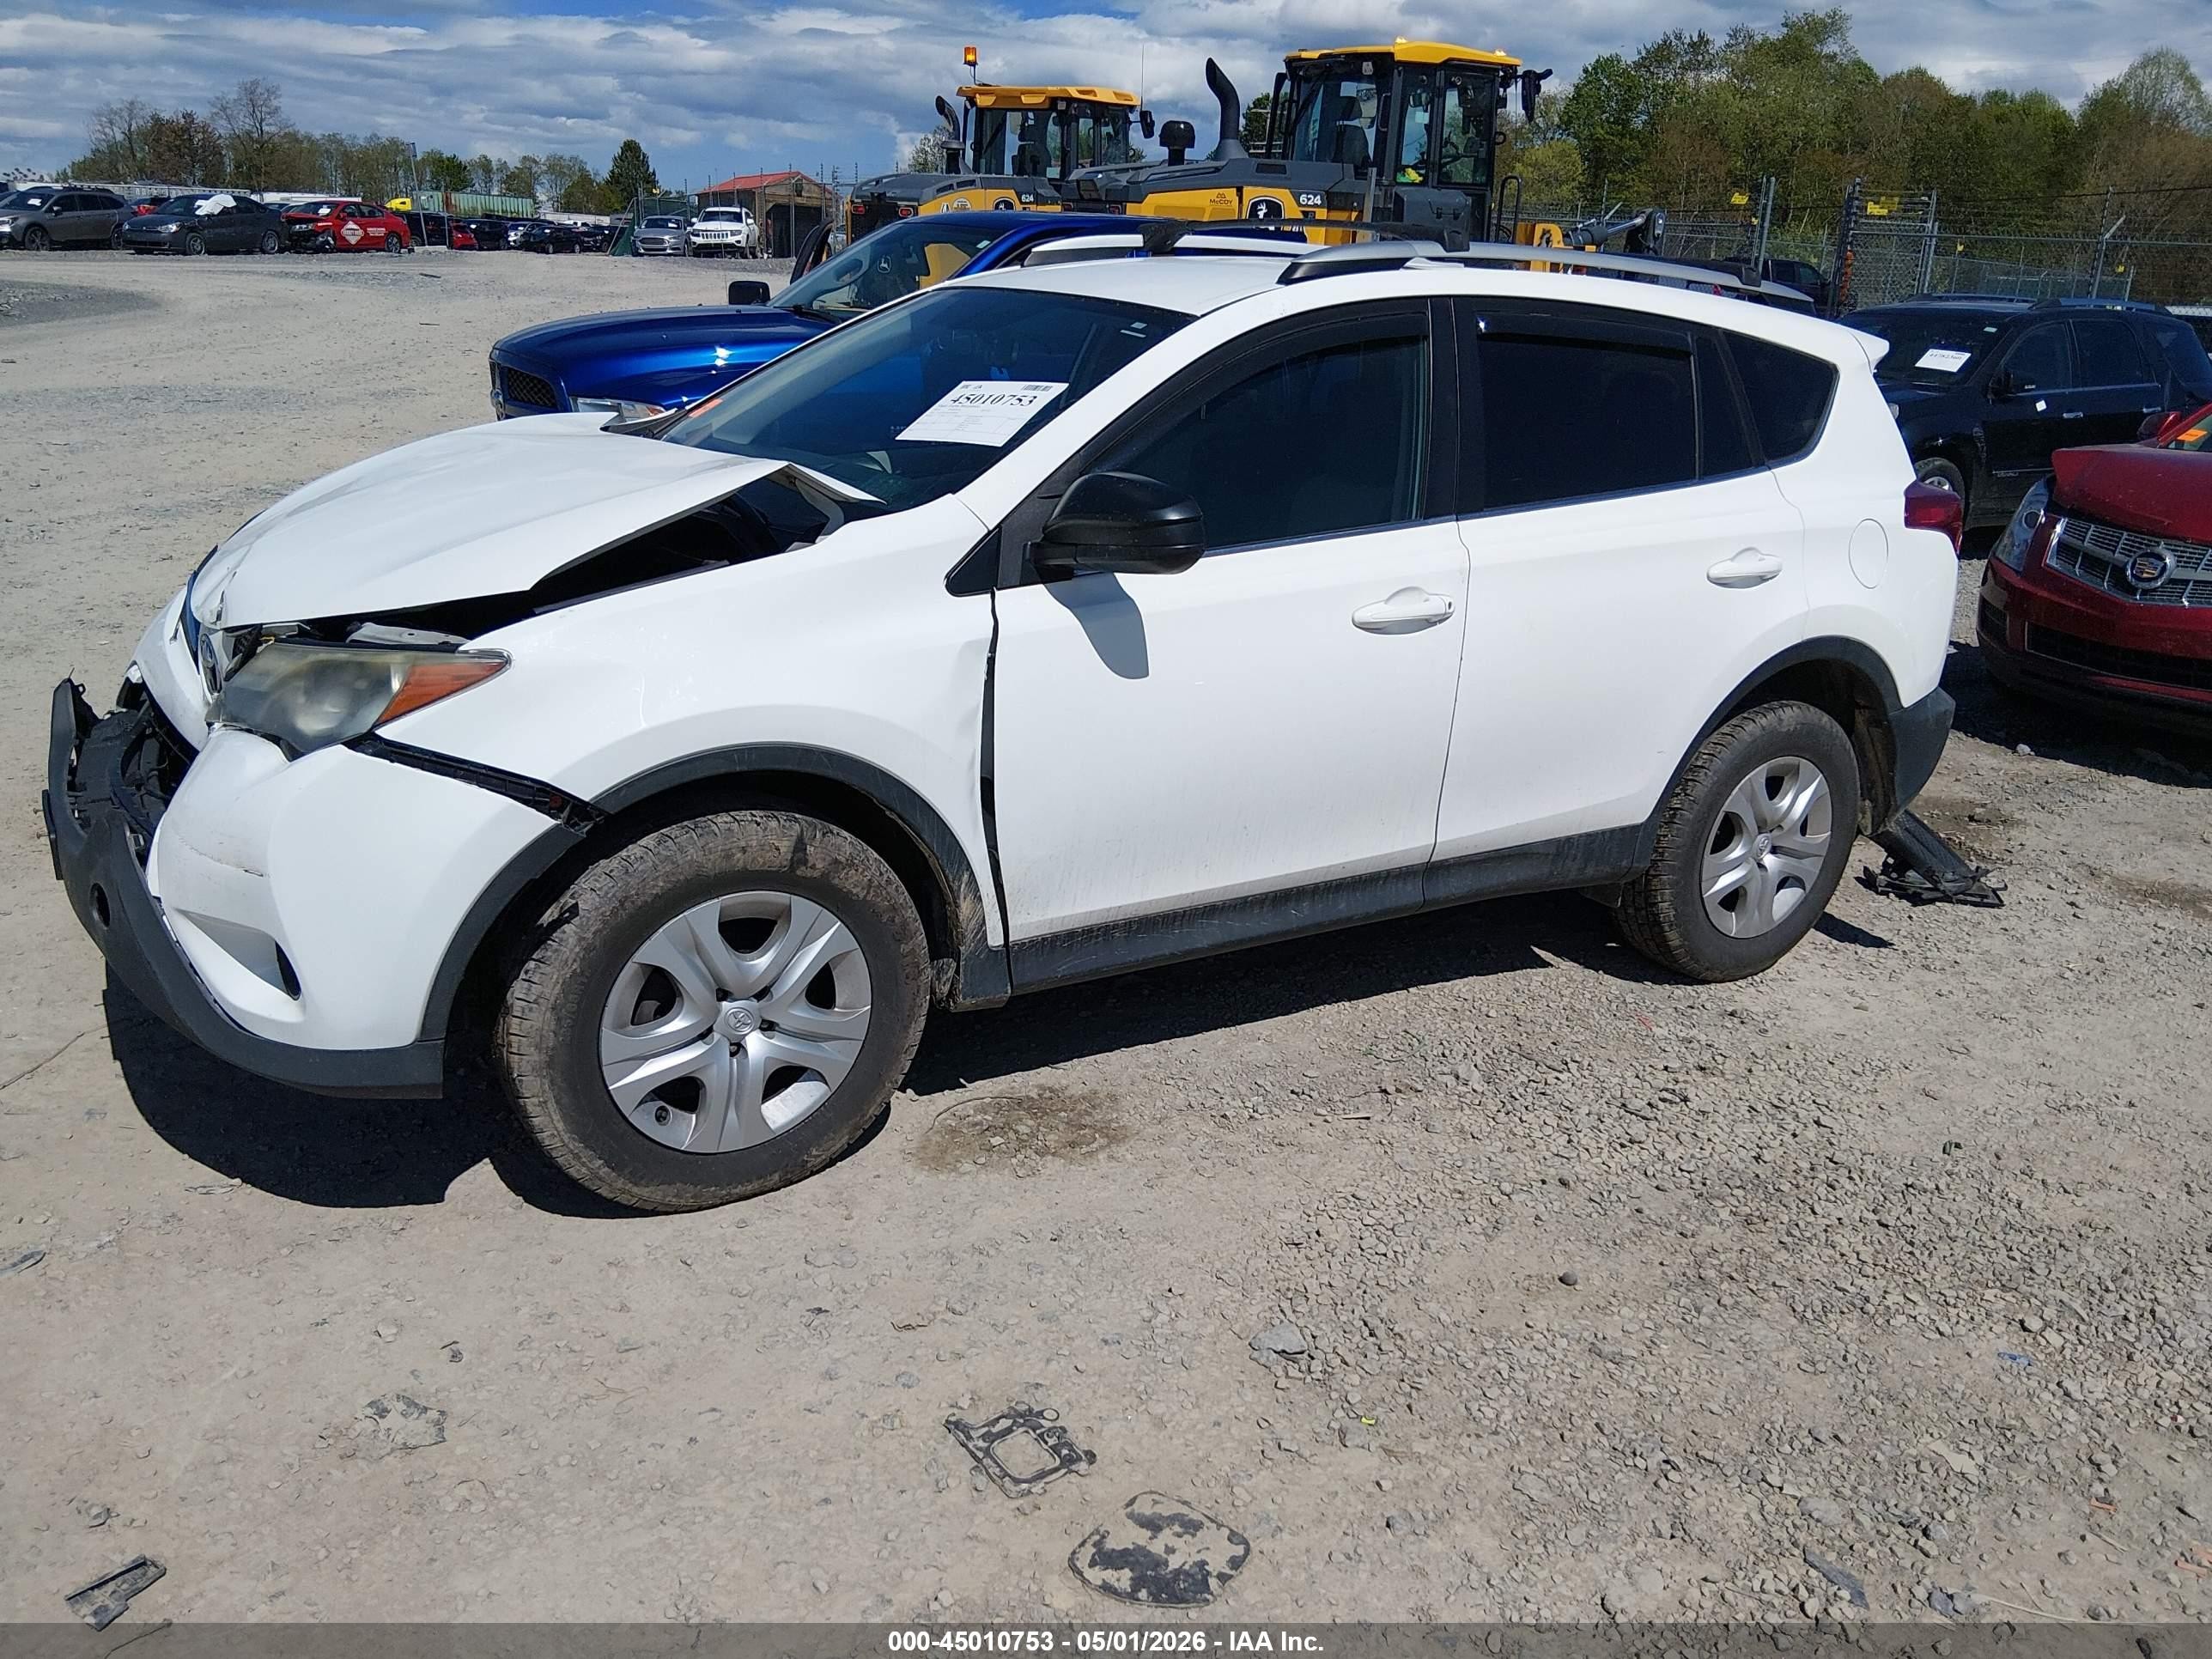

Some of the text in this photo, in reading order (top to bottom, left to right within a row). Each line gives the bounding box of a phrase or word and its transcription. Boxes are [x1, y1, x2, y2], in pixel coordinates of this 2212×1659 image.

[1021, 193, 1035, 203] 624
[1299, 193, 1322, 206] 624
[950, 392, 1038, 407] 45010753
